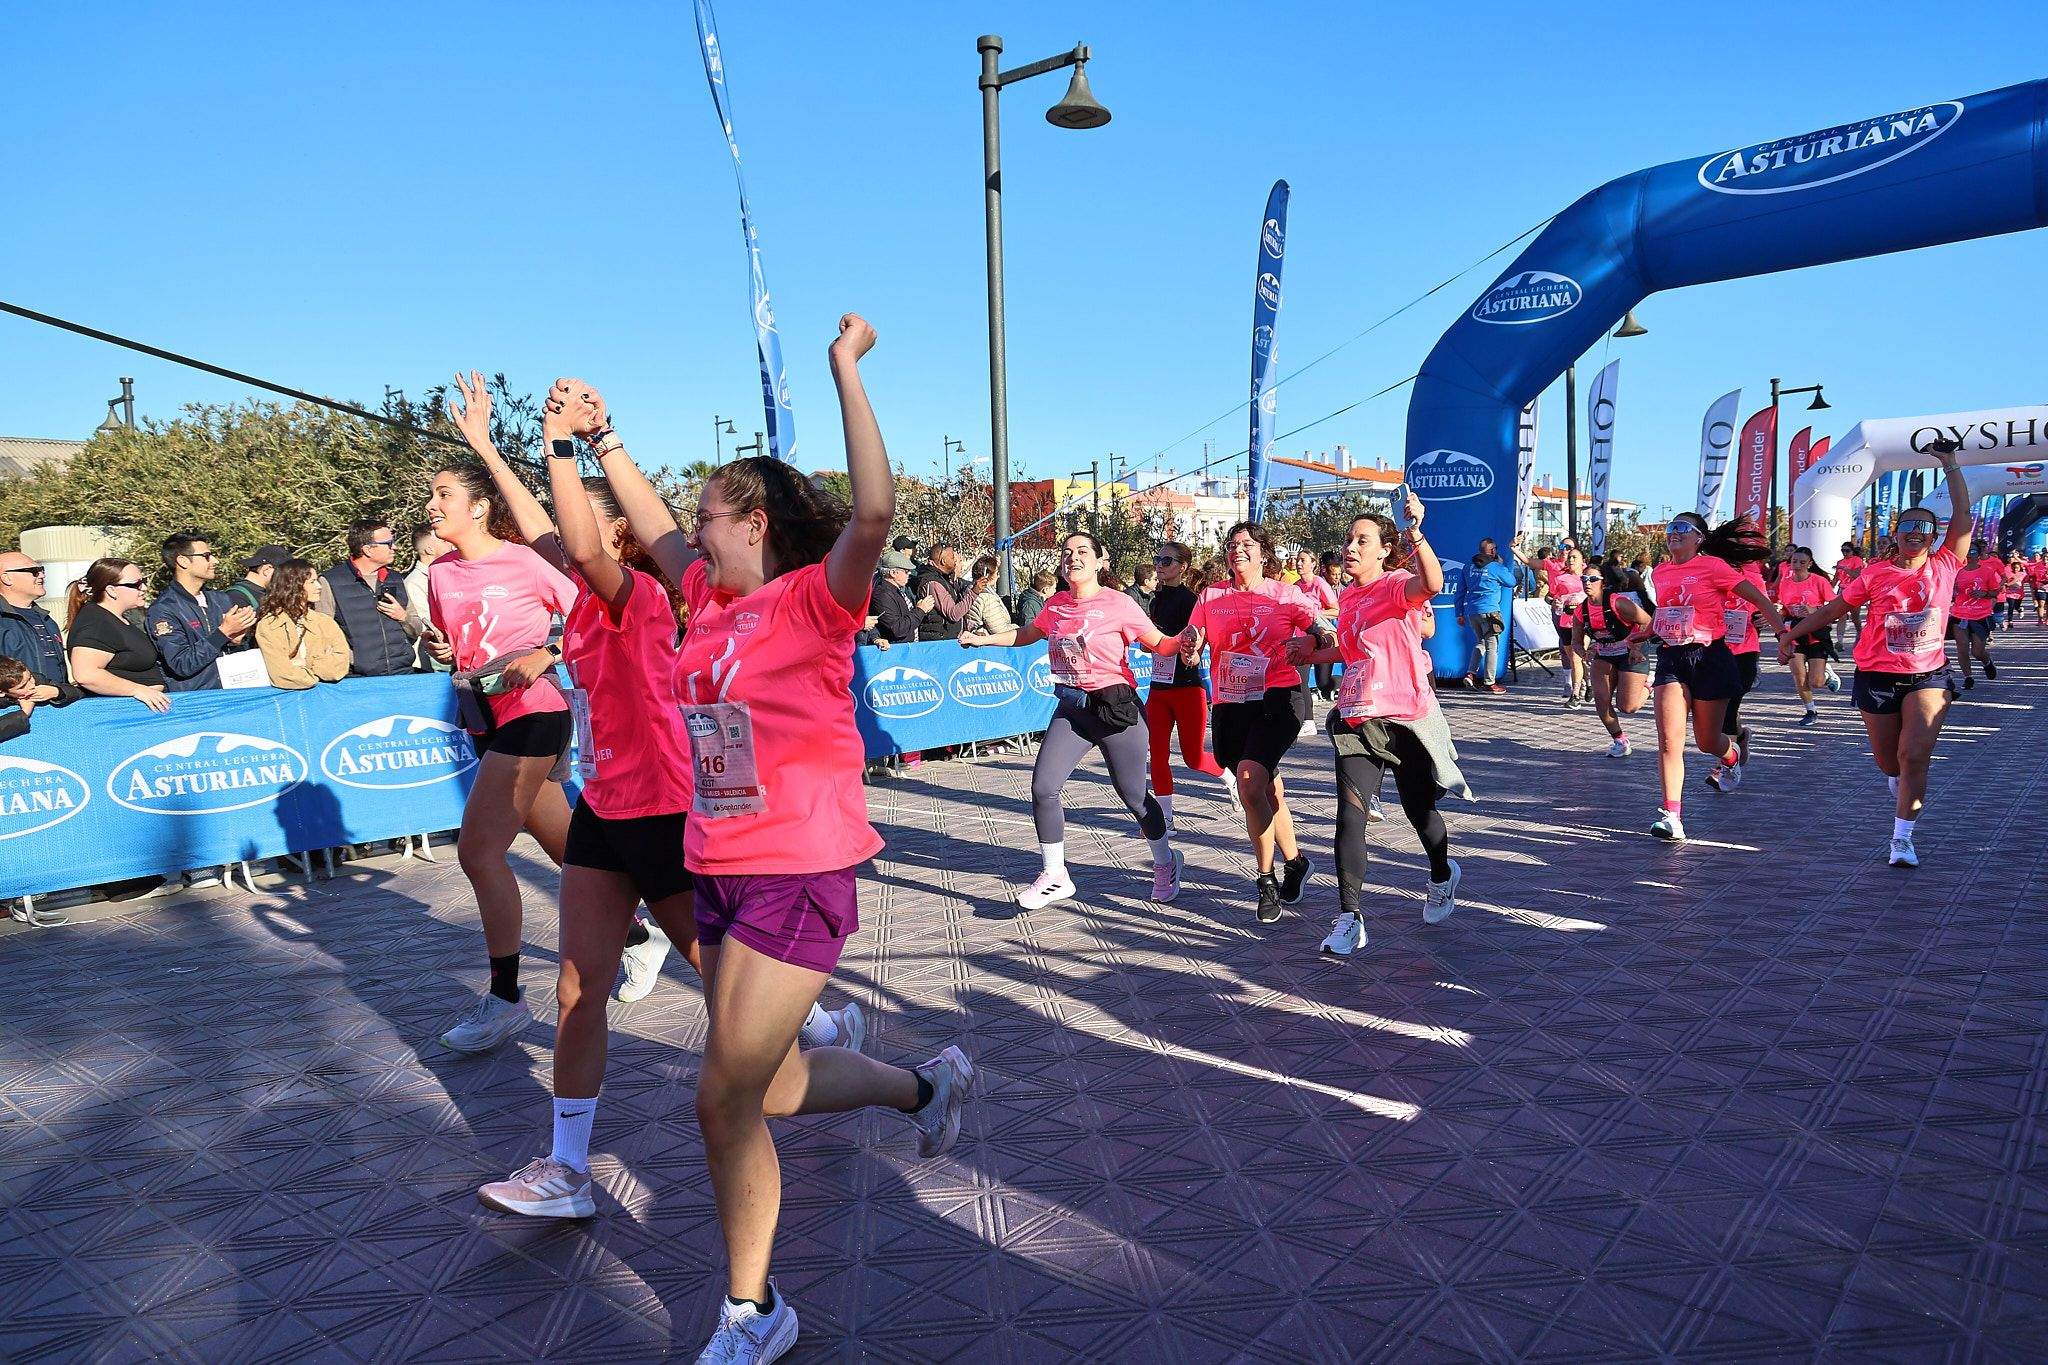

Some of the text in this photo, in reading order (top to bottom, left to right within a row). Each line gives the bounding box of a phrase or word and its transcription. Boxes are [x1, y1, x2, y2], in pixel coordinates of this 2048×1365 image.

[1714, 112, 1940, 184] ASTURIANA
[1531, 284, 1569, 293] LECHERA
[1477, 291, 1573, 317] ASTURIANA
[1910, 418, 2048, 454] OYSH
[1749, 430, 1765, 502] Santander
[1817, 464, 1863, 475] OYSHO
[1408, 470, 1487, 489] ASTURIANA
[1797, 519, 1838, 530] OYSHO
[1906, 629, 1927, 639] 016
[872, 688, 940, 708] ASTURIANA
[956, 678, 1020, 699] ASTURIANA
[358, 740, 413, 751] CENTRAL
[154, 752, 287, 773] CENTRAL LECHERA
[336, 744, 476, 777] ASTURIANA
[126, 763, 296, 801] ASTURIANA
[720, 804, 752, 812] Santander
